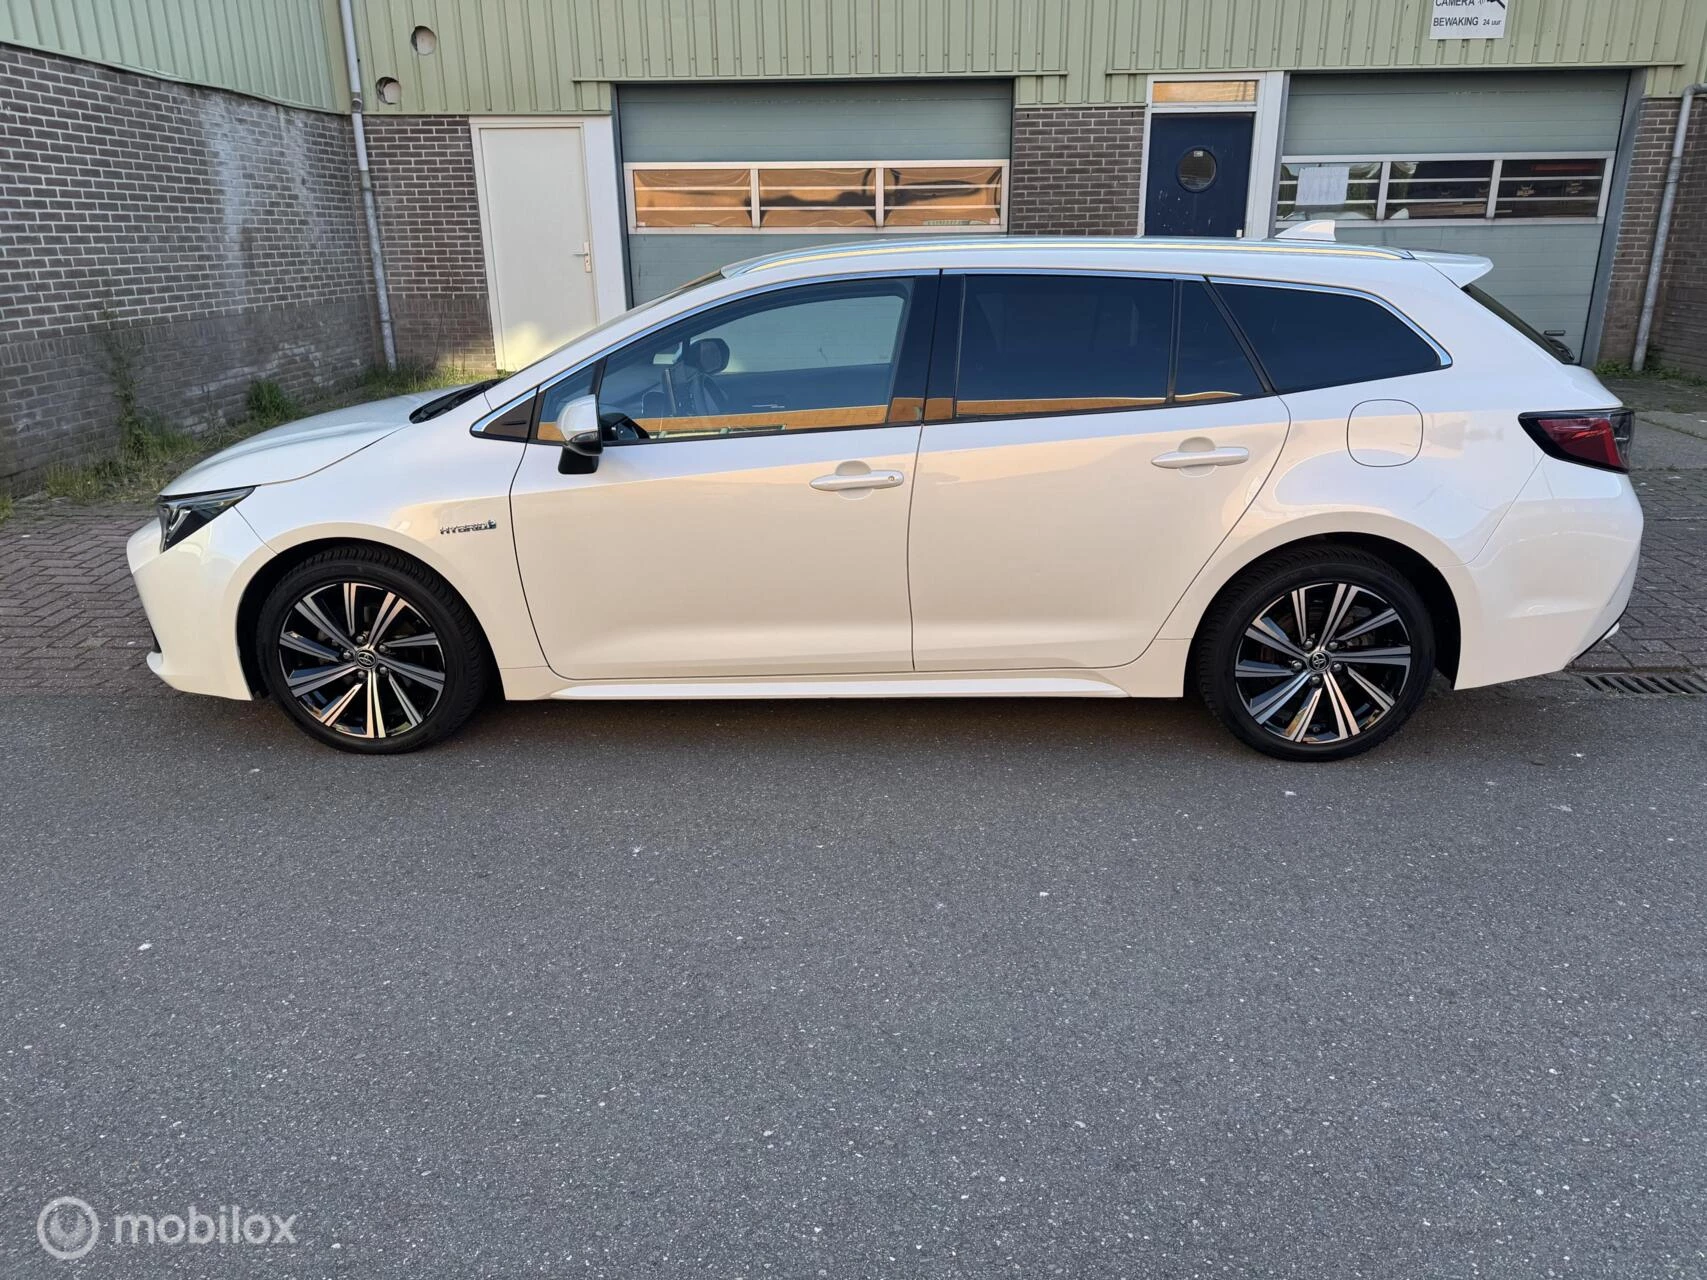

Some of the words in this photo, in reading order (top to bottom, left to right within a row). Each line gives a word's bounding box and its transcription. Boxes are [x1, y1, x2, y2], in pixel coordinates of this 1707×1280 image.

[1433, 16, 1479, 27] BEWAKING
[1482, 18, 1490, 26] 24
[440, 522, 488, 534] HYBRID
